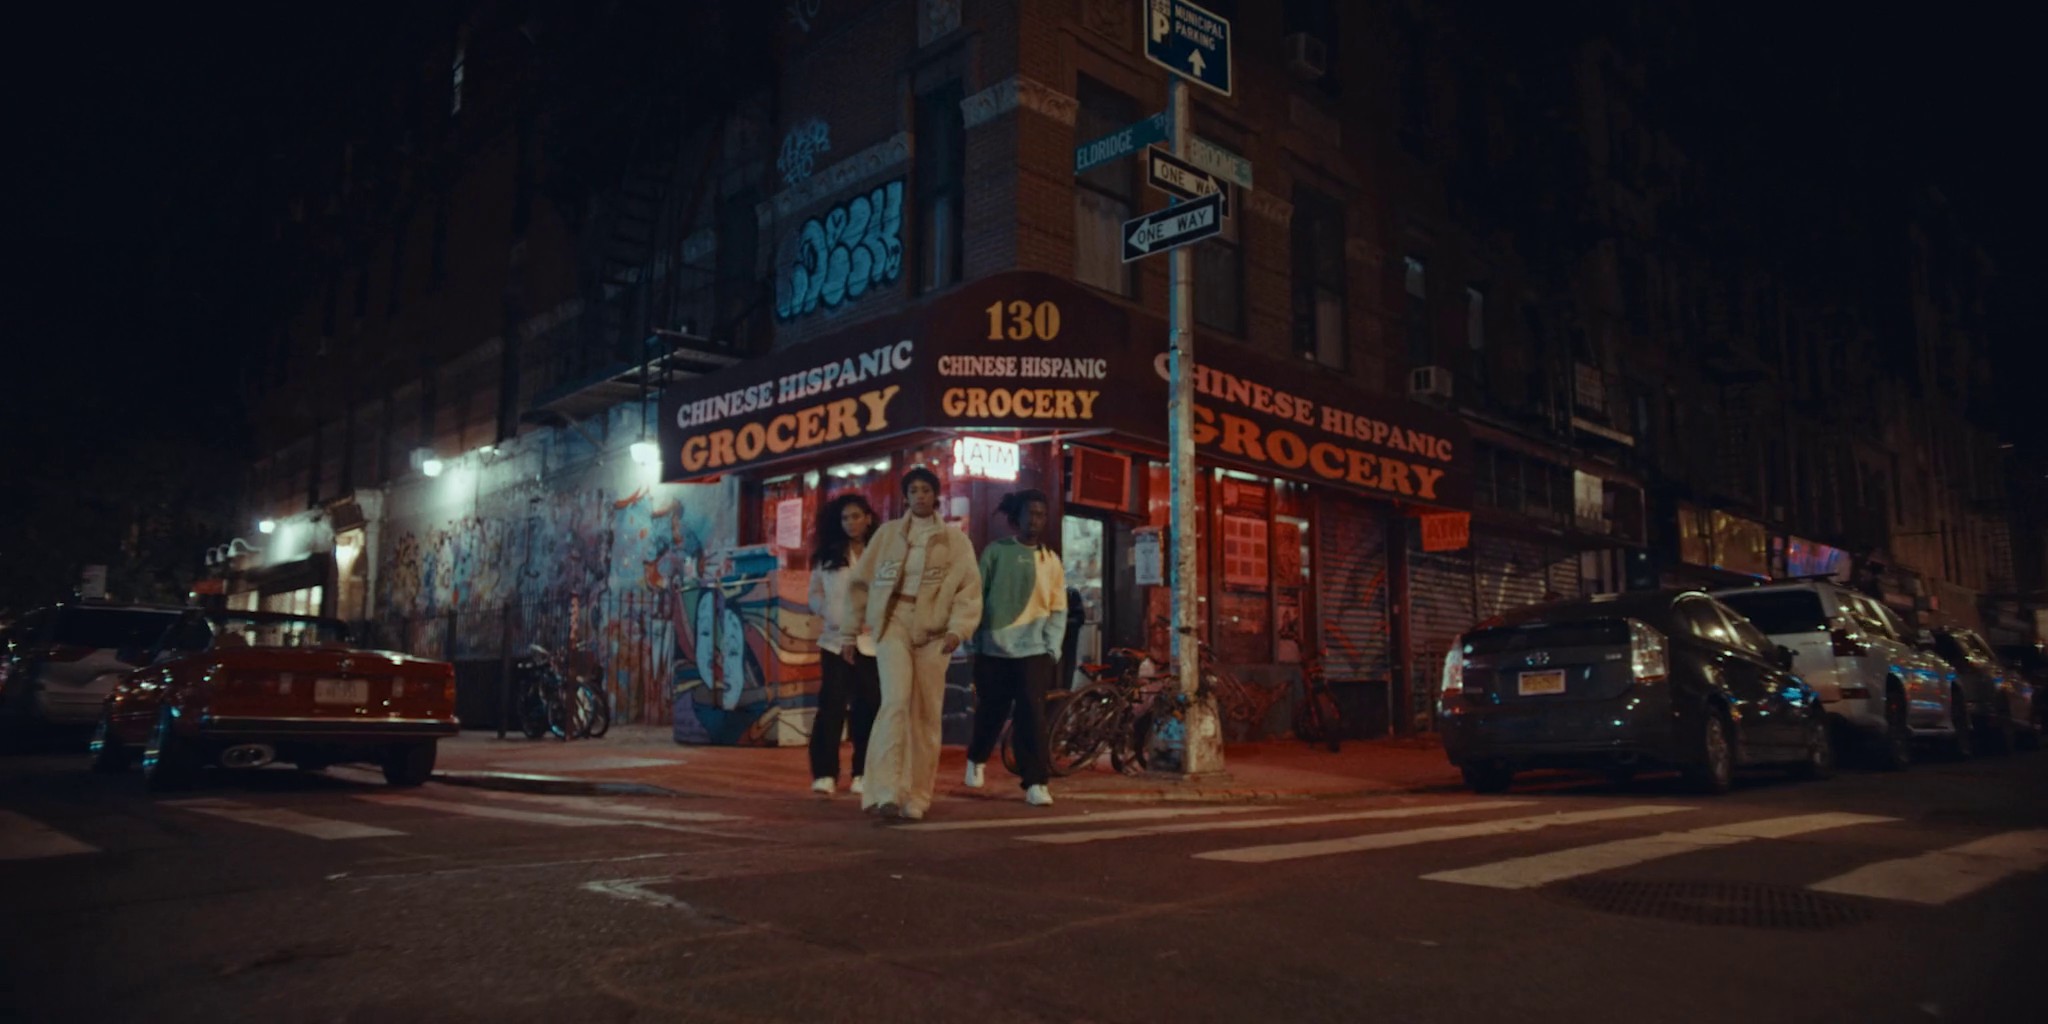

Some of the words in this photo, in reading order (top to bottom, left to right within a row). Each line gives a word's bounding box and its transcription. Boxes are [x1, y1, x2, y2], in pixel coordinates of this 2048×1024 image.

[1174, 3, 1225, 39] MUNICIPAL
[1174, 20, 1216, 51] PARKING
[1076, 128, 1134, 170] ELDRIDGE
[1191, 139, 1237, 177] BROOME
[1161, 164, 1184, 186] ONE
[1137, 223, 1165, 244] ONE
[1177, 209, 1208, 232] WAY
[985, 299, 1061, 341] 130
[677, 380, 774, 428] CHINESE
[777, 340, 914, 404] HISPANIC
[937, 355, 1018, 378] CHINESE
[1020, 356, 1107, 379] HISPANIC
[941, 386, 1100, 420] GROCERY
[681, 384, 900, 472] GROCERY
[1320, 405, 1453, 462] HISPANIC
[971, 443, 1014, 466] ATM
